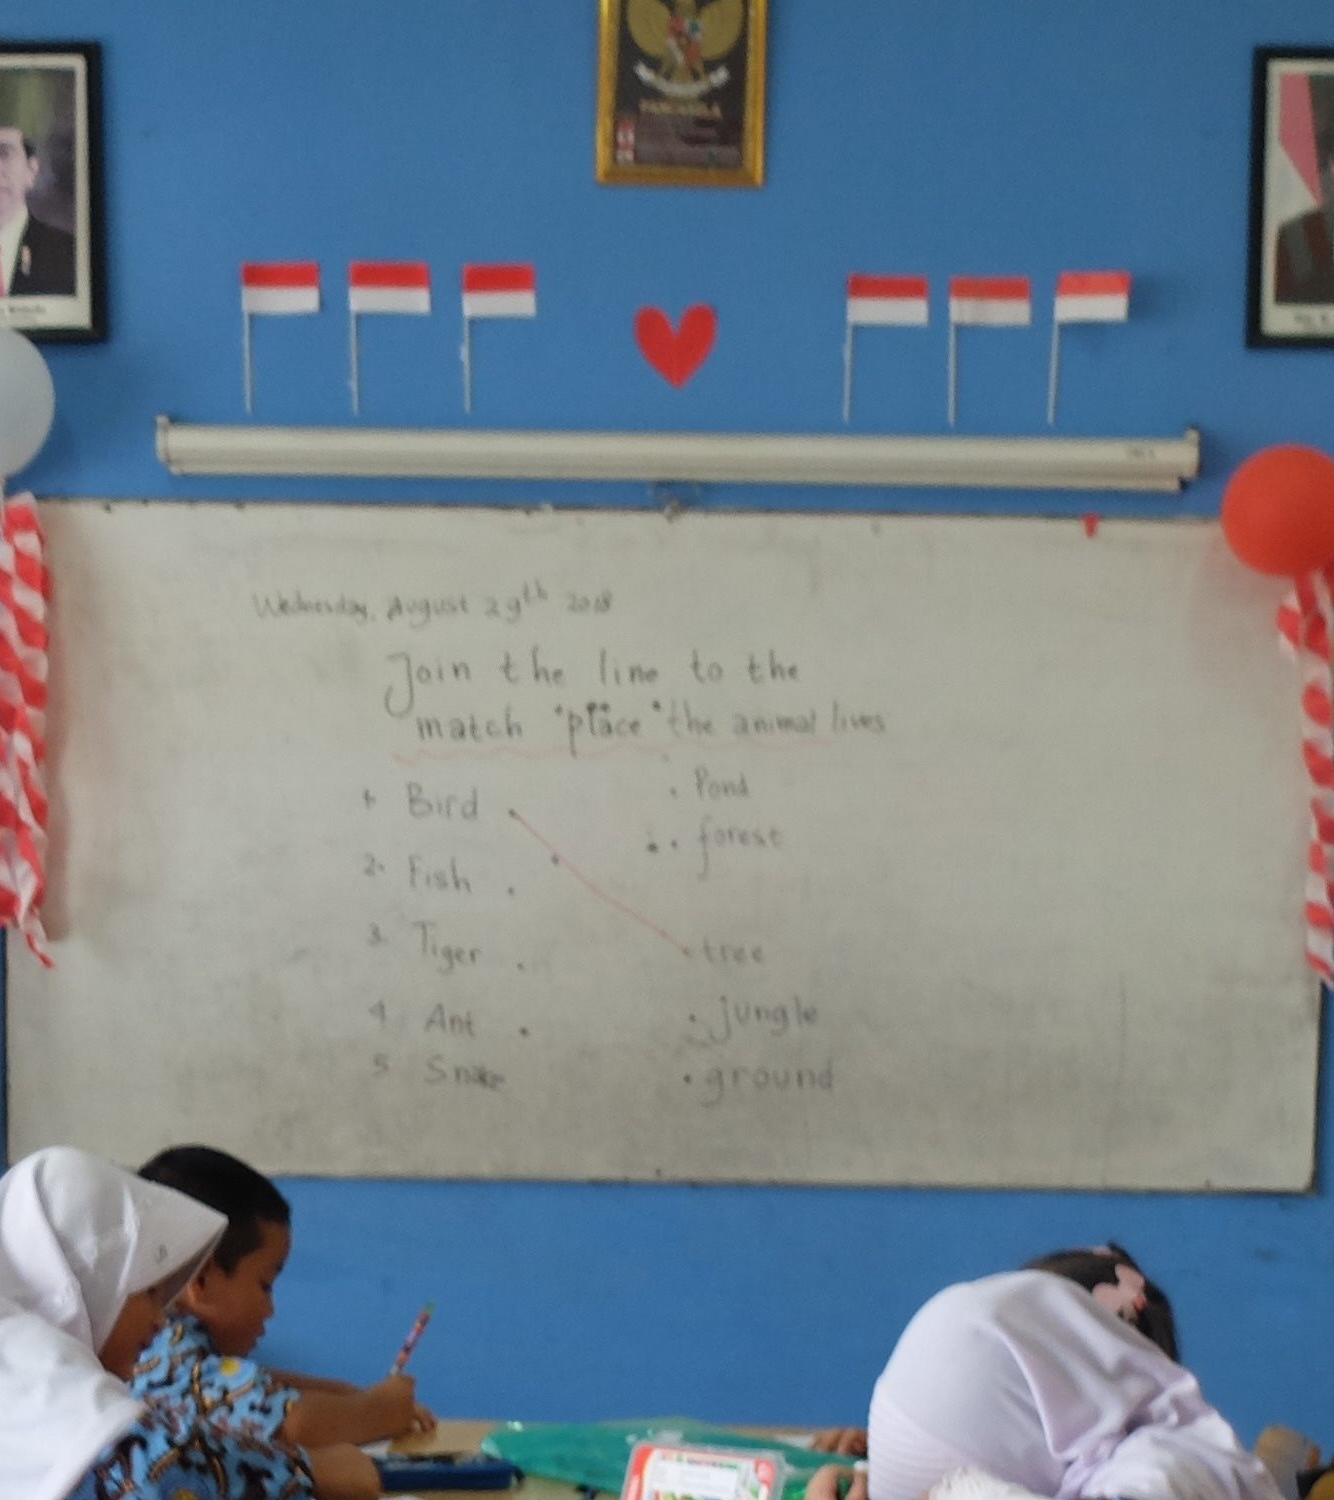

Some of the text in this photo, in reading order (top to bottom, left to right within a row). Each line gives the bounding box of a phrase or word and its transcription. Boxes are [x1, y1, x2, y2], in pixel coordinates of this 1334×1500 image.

[384, 646, 800, 718] Join the line to the
[416, 705, 524, 742] match
[407, 782, 479, 821] Bird
[408, 854, 472, 895] Fish
[412, 919, 484, 976] Tiger
[702, 935, 766, 965] tree
[424, 1002, 477, 1038] Ant
[701, 1052, 836, 1109] ground
